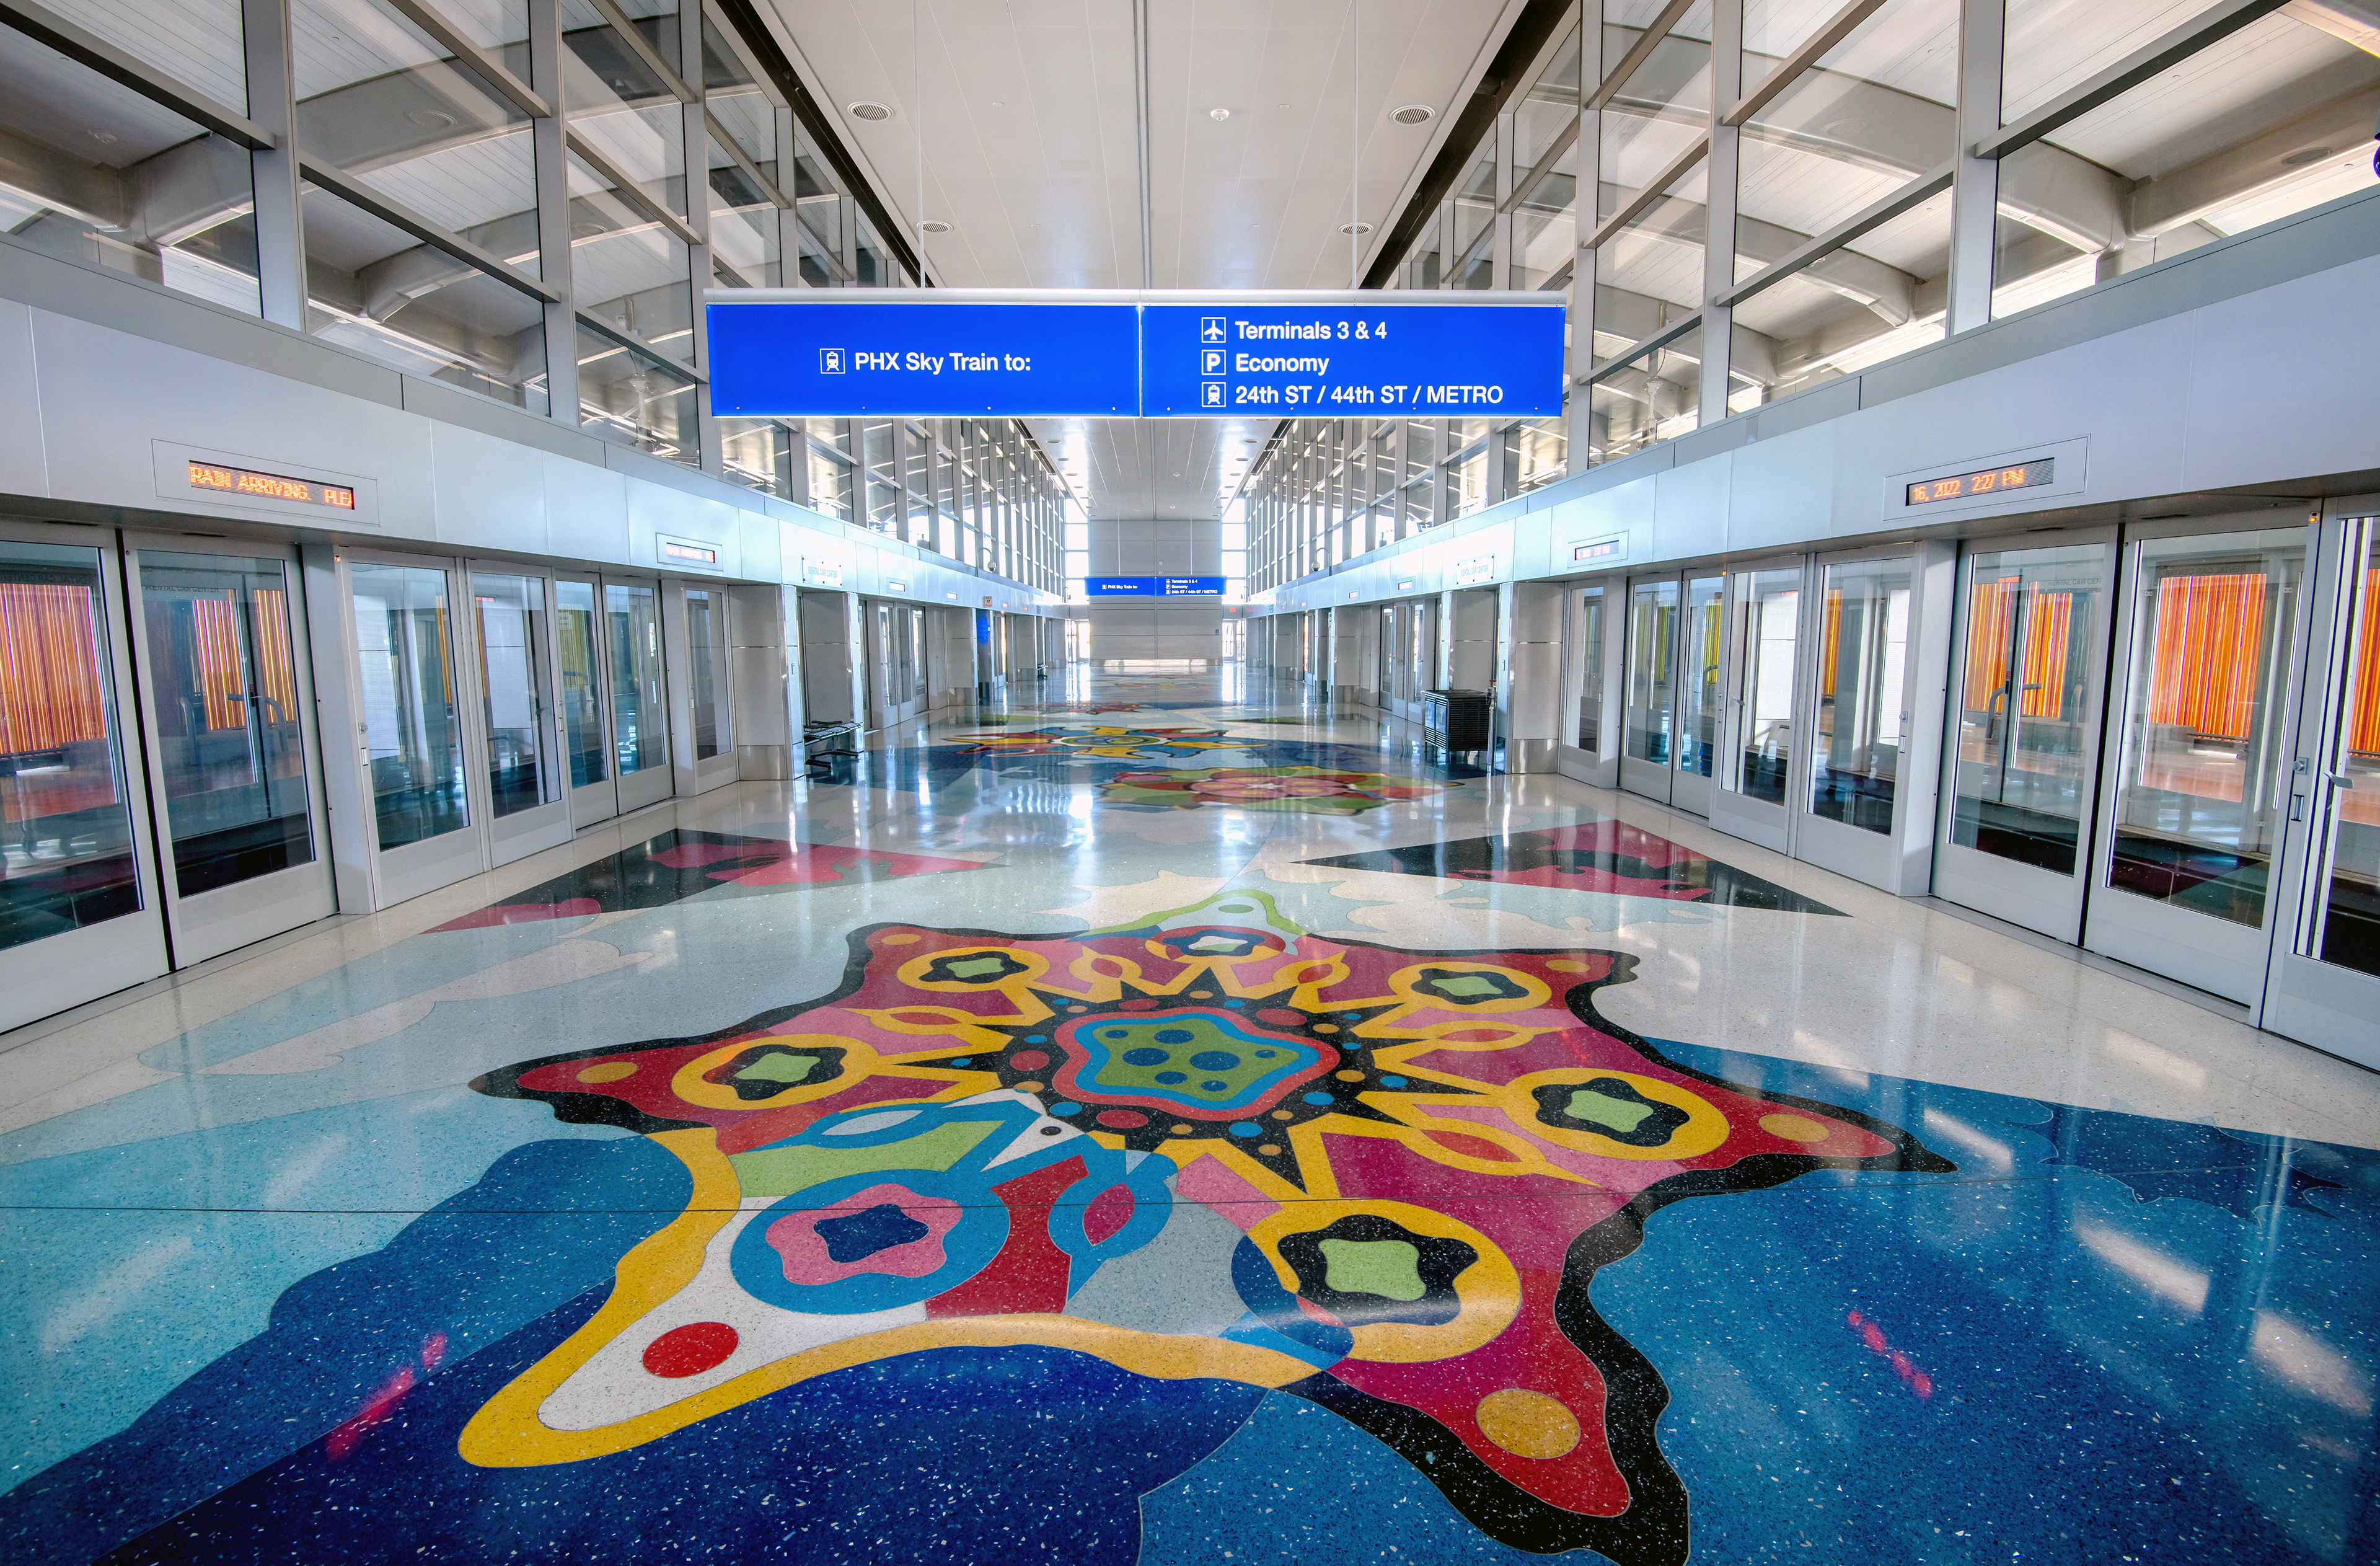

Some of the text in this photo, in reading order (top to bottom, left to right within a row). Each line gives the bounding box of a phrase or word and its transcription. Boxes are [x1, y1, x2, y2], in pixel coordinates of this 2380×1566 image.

[1235, 321, 1387, 340] Terminals 3 & 4
[855, 352, 1031, 375] PHX Sky Train to:
[1236, 353, 1329, 376] Economy
[1235, 385, 1504, 404] 24th ST / 44th ST / METRO
[189, 466, 232, 489] RAIN
[1913, 485, 1929, 502] 16,
[1933, 479, 1960, 498] 2022
[2001, 468, 2025, 487] PM
[827, 570, 838, 578] CENTER
